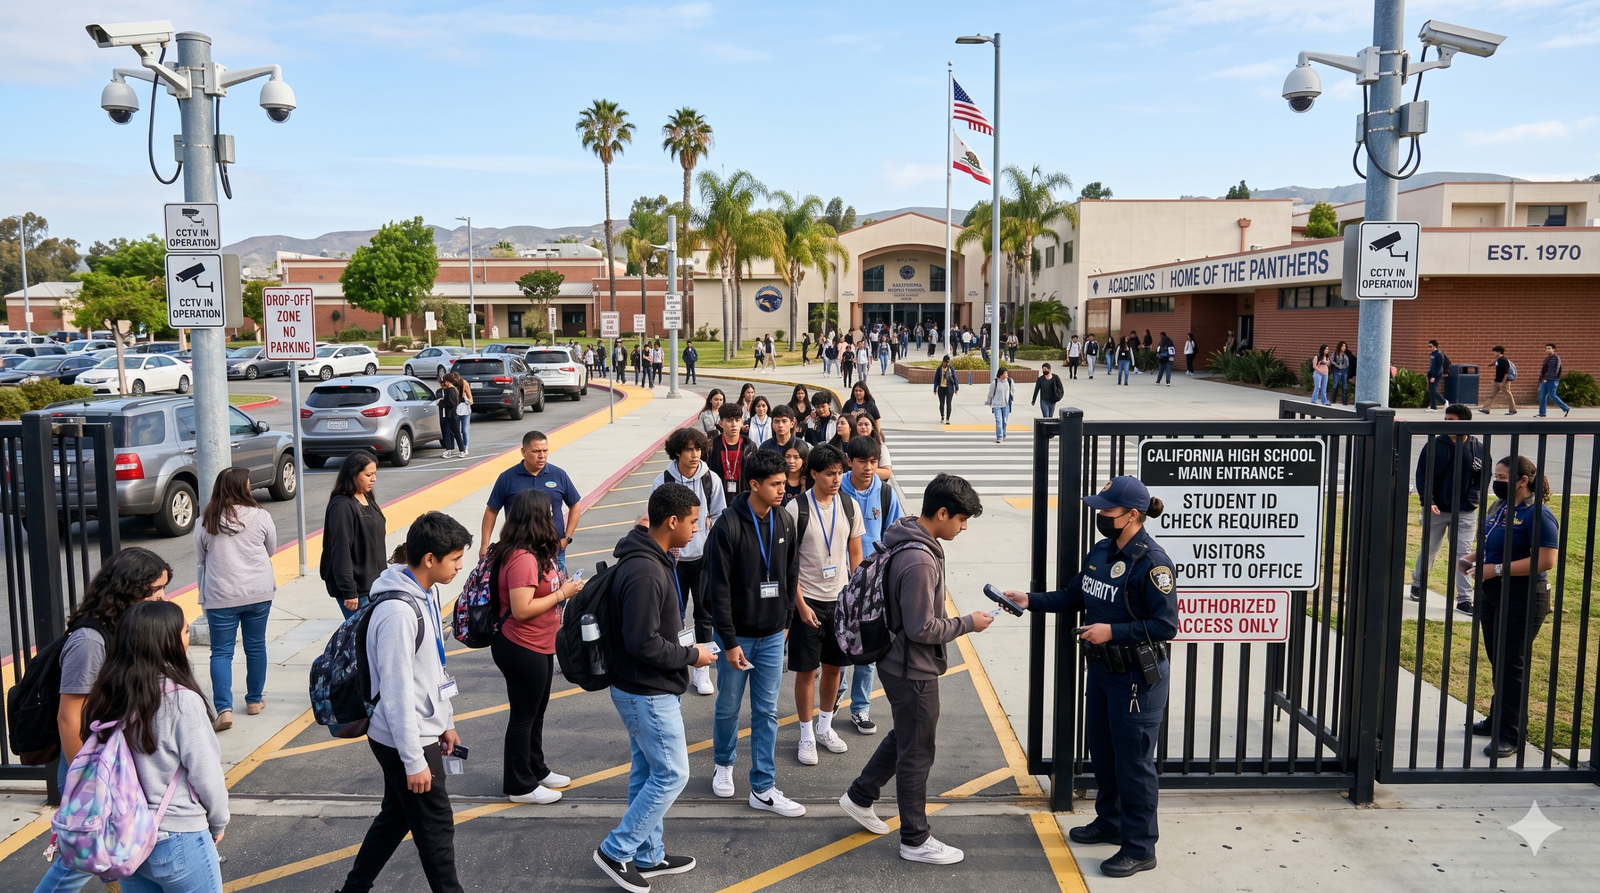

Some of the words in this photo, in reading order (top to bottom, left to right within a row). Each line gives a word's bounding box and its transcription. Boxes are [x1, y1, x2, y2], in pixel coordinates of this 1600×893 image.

[176, 229, 198, 237] CCTV
[200, 229, 209, 237] IN
[170, 238, 216, 246] OPERATION
[1488, 245, 1528, 260] EST.
[1536, 245, 1581, 260] 1970
[1108, 273, 1155, 293] ACADEMICS
[1170, 267, 1200, 287] HOME
[1203, 265, 1218, 284] OF
[1222, 261, 1245, 283] THE
[1250, 250, 1328, 280] PANTHERS
[1370, 268, 1393, 277] CCTV
[1396, 268, 1405, 277] IN
[1362, 279, 1413, 289] OPERATION
[179, 298, 201, 307] CCTV
[204, 298, 213, 307] IN
[266, 294, 310, 306] DROP-OFF
[173, 310, 221, 318] OPERATION
[277, 311, 301, 322] ZONE
[283, 326, 296, 338] NO
[271, 342, 310, 353] PARKING
[1148, 449, 1224, 462] CALIFORNIA
[1228, 449, 1259, 462] HIGH
[1264, 449, 1315, 462] SCHOOL
[1178, 467, 1211, 479] MAIN
[1217, 467, 1284, 479] ENTRANCE
[1184, 494, 1256, 508] STUDENT
[1262, 494, 1276, 508] ID
[1161, 514, 1212, 528] CHECK
[1219, 514, 1298, 528] REQUIRED
[1193, 544, 1265, 559] VISITORS
[1176, 564, 1216, 578] PORT
[1222, 564, 1241, 578] TO
[1248, 564, 1302, 578] OFFICE
[1082, 574, 1118, 602] SECURITY
[1178, 599, 1275, 613] AUTHORIZED
[1239, 618, 1278, 633] ONLY
